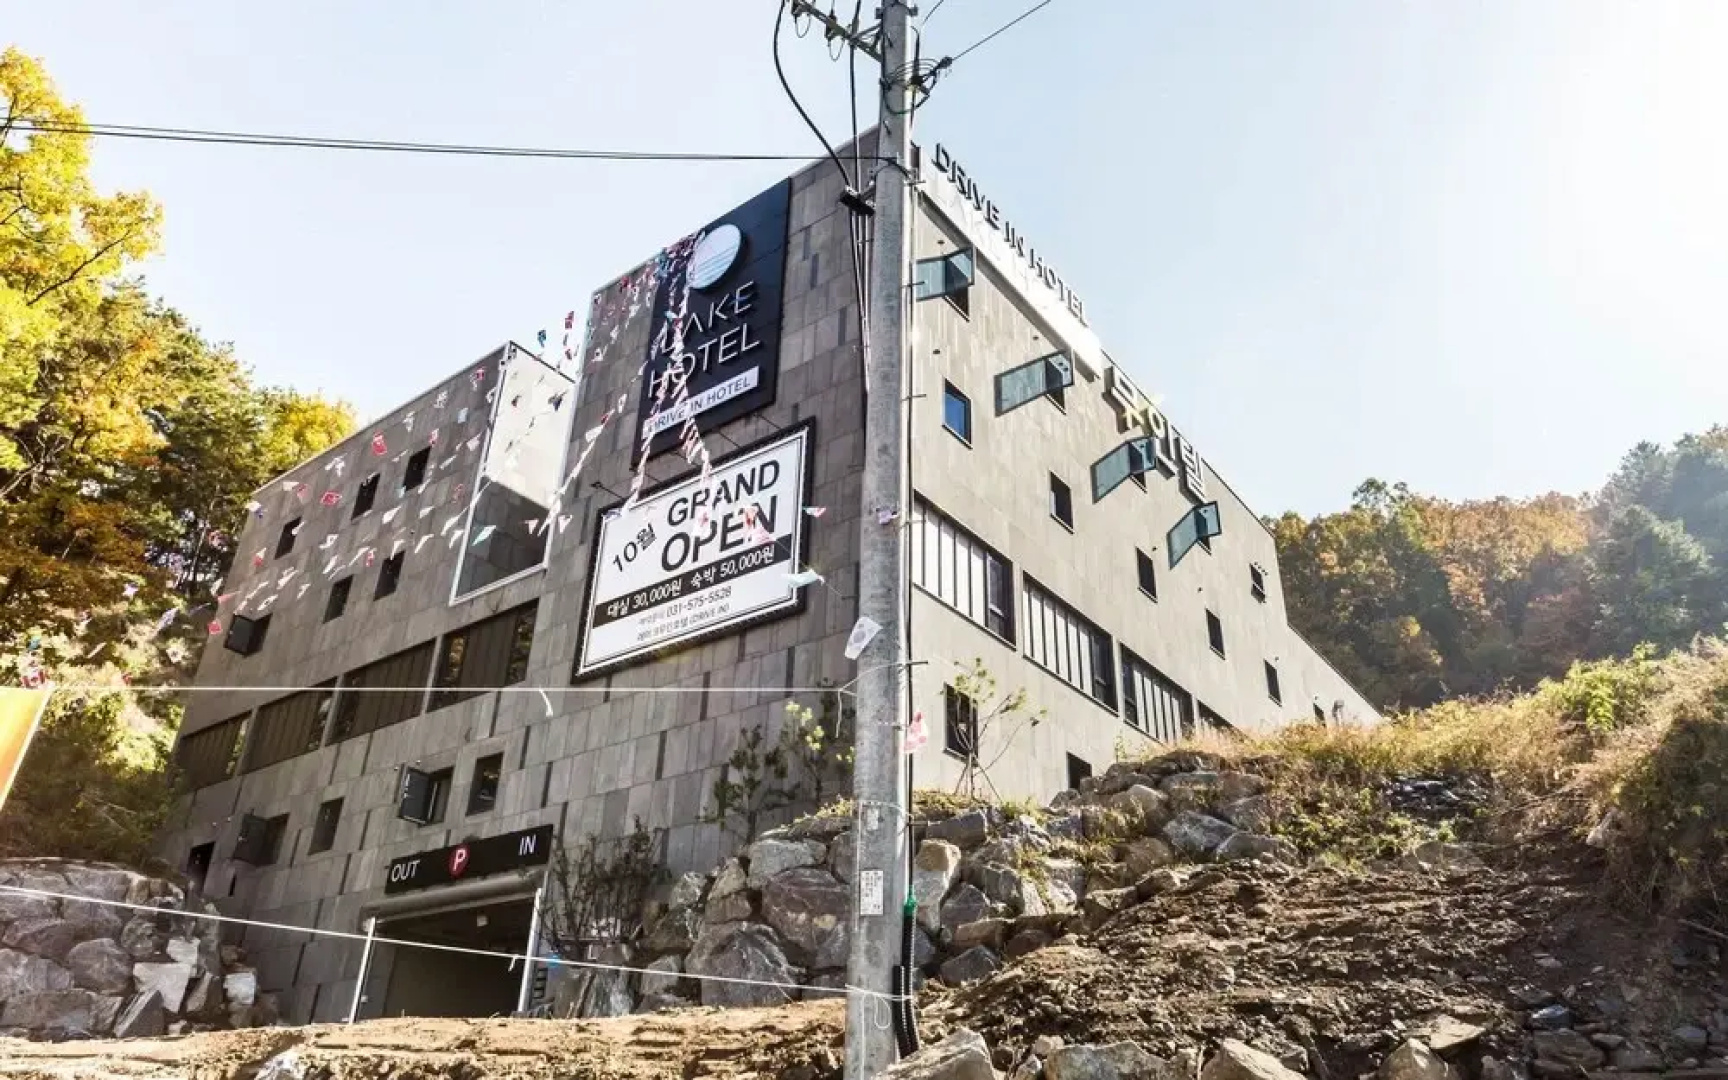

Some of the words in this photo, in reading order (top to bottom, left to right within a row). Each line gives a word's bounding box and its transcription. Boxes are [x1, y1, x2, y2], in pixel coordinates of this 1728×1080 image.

[931, 143, 1000, 230] DRIVE
[1004, 221, 1024, 257] IN
[1030, 248, 1088, 328] HOTEL
[661, 280, 755, 354] LAKE
[647, 322, 761, 399] HOTEL
[690, 399, 703, 412] IN
[706, 375, 751, 403] HOTEL
[667, 459, 780, 528] GRAND
[612, 521, 657, 573] 10월
[661, 494, 778, 573] OPEN
[607, 596, 630, 618] 대실
[632, 578, 682, 609] 30,000원
[690, 567, 717, 589] 숙박
[720, 543, 775, 578] 50,000원
[391, 859, 421, 883] OUT
[453, 847, 466, 872] P
[519, 834, 537, 856] IN
